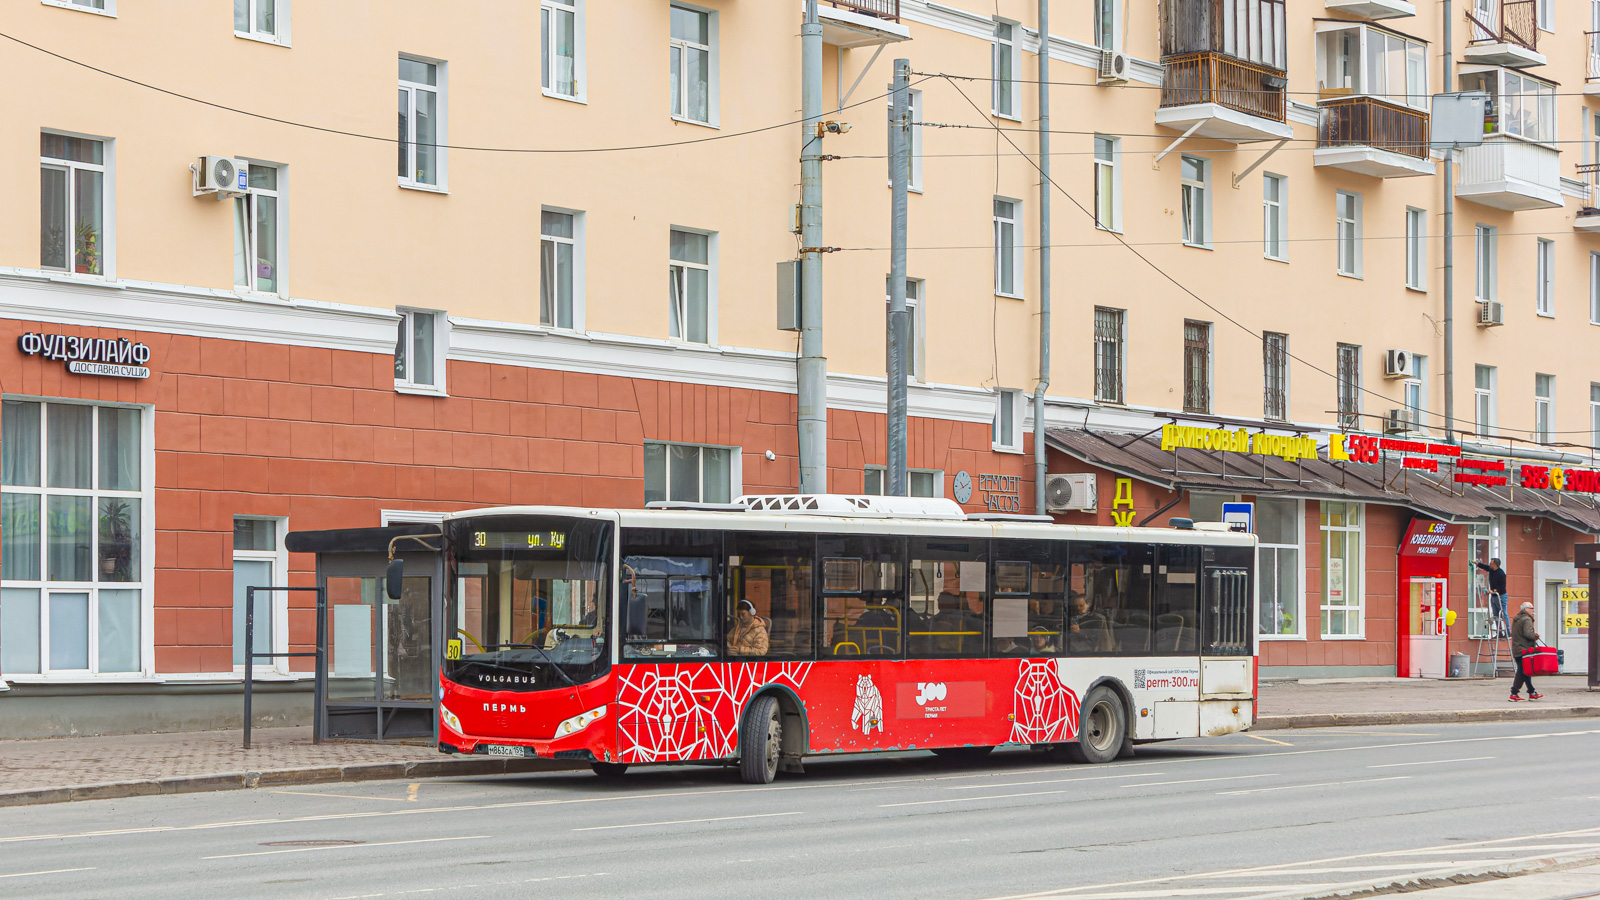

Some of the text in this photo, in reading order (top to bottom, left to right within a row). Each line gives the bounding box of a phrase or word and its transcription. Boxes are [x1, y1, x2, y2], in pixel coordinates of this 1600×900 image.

[20, 332, 150, 365] ФУДЗИЛАЙФ
[73, 362, 147, 377] ДОСТАВКА СУШИ
[1161, 424, 1319, 462] ДЖИНСОВЫЙ КЛОНДАЙК
[979, 473, 1021, 493] РЕМОНТ
[1520, 464, 1549, 489] 585
[984, 493, 1020, 512] ЧАСОВ
[474, 531, 486, 546] 30
[528, 533, 544, 548] ул.
[1410, 534, 1454, 546] ЮВЕЛИРНЫЙ
[1417, 546, 1438, 554] МАГАЗИН
[448, 645, 459, 660] 30
[479, 674, 536, 684] VOLGABUS
[1146, 676, 1199, 690] perm-300.ru
[483, 703, 526, 713] ПЕРМЬ
